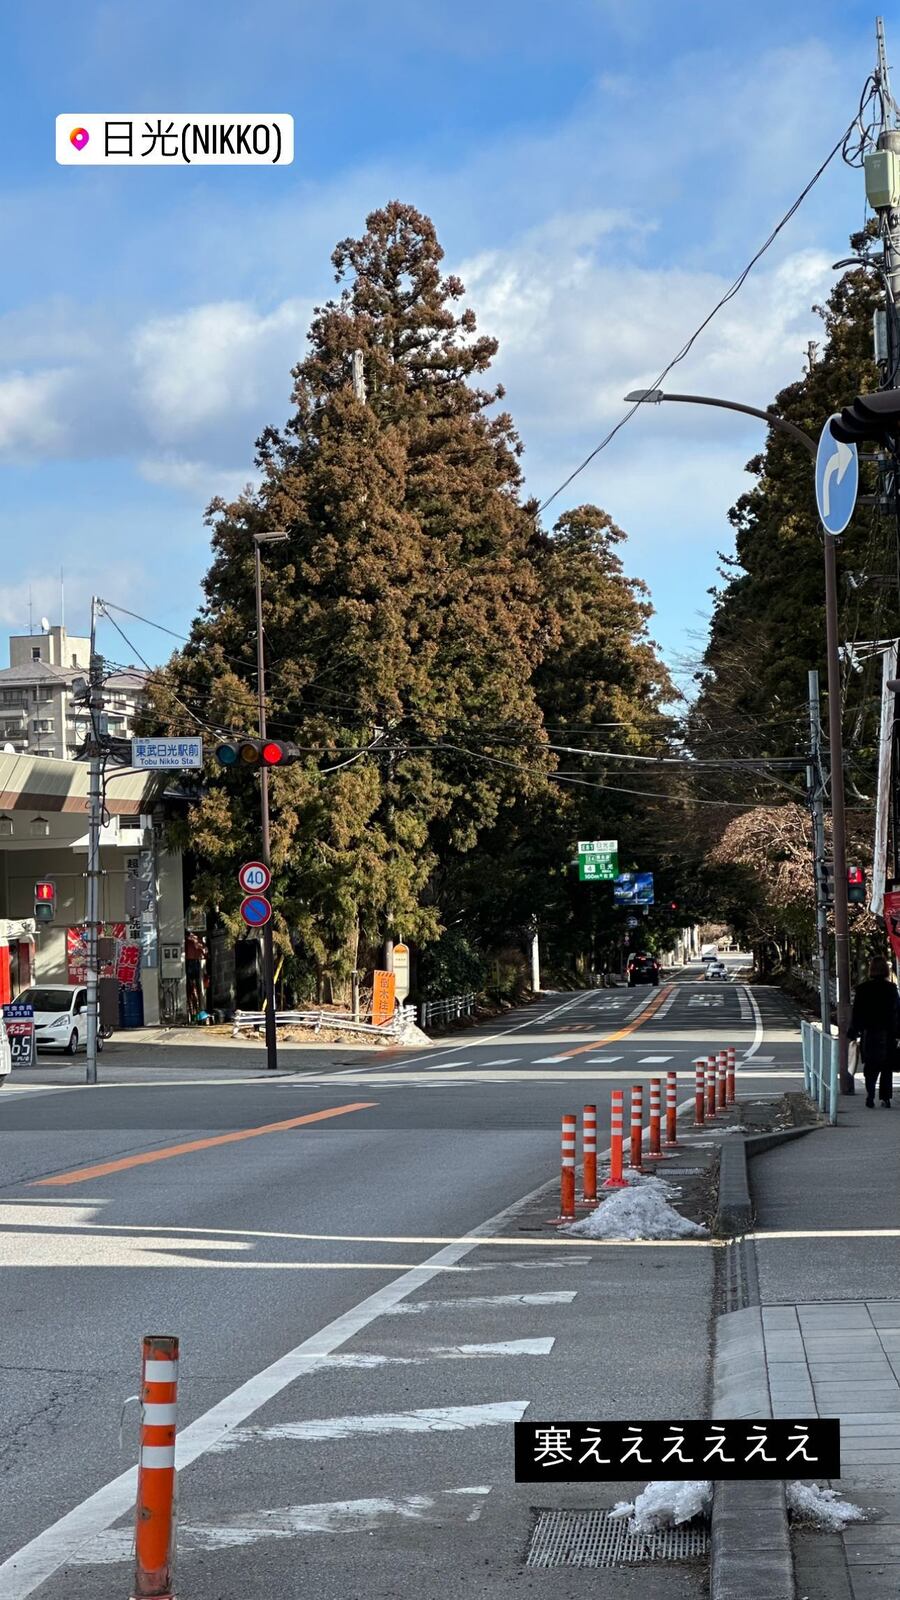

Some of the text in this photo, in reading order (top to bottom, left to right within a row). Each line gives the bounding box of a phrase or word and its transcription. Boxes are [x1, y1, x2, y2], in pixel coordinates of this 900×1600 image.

[136, 744, 199, 757] 東武日光駅前
[247, 871, 263, 884] 40
[115, 944, 138, 983] 洗車
